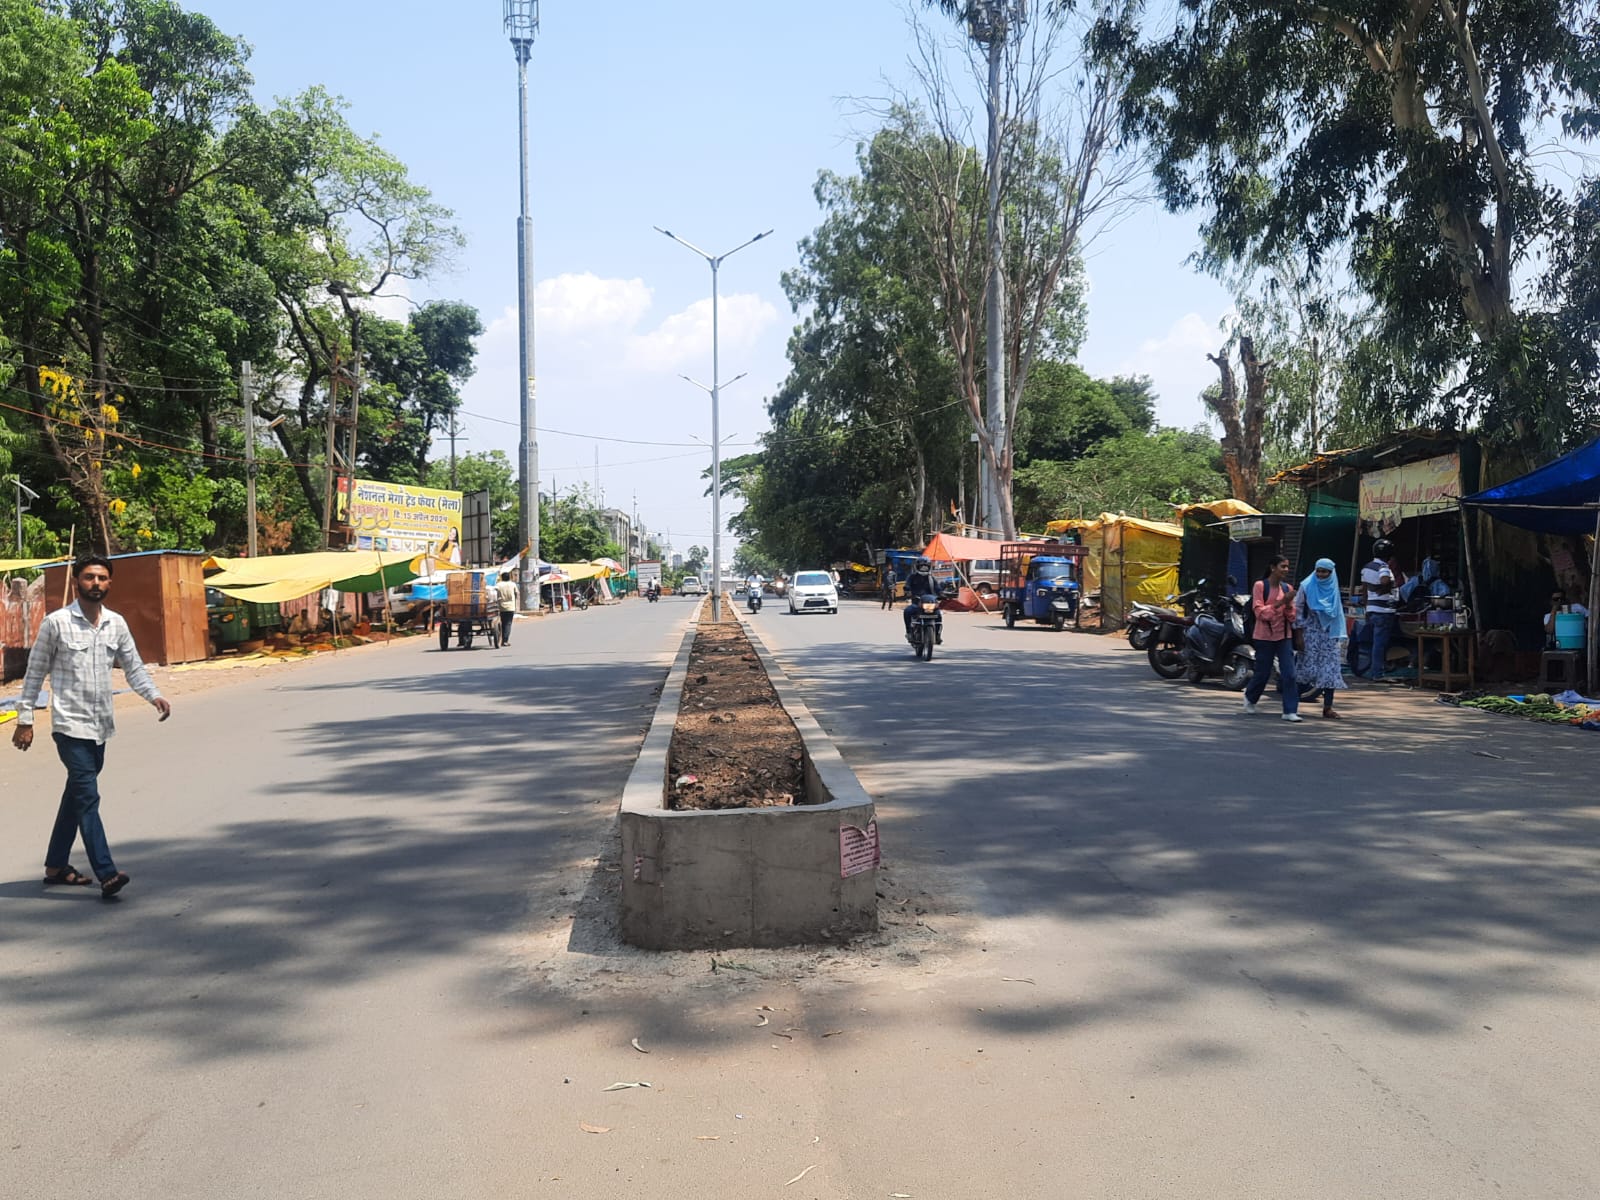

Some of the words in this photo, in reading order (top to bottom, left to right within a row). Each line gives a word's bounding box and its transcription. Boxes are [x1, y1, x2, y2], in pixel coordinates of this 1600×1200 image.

[358, 487, 386, 503] नेशनल
[388, 491, 404, 505] मेगा
[406, 492, 416, 507] ट्रेड
[418, 494, 436, 508] फेयर
[438, 496, 462, 513] (मेला)
